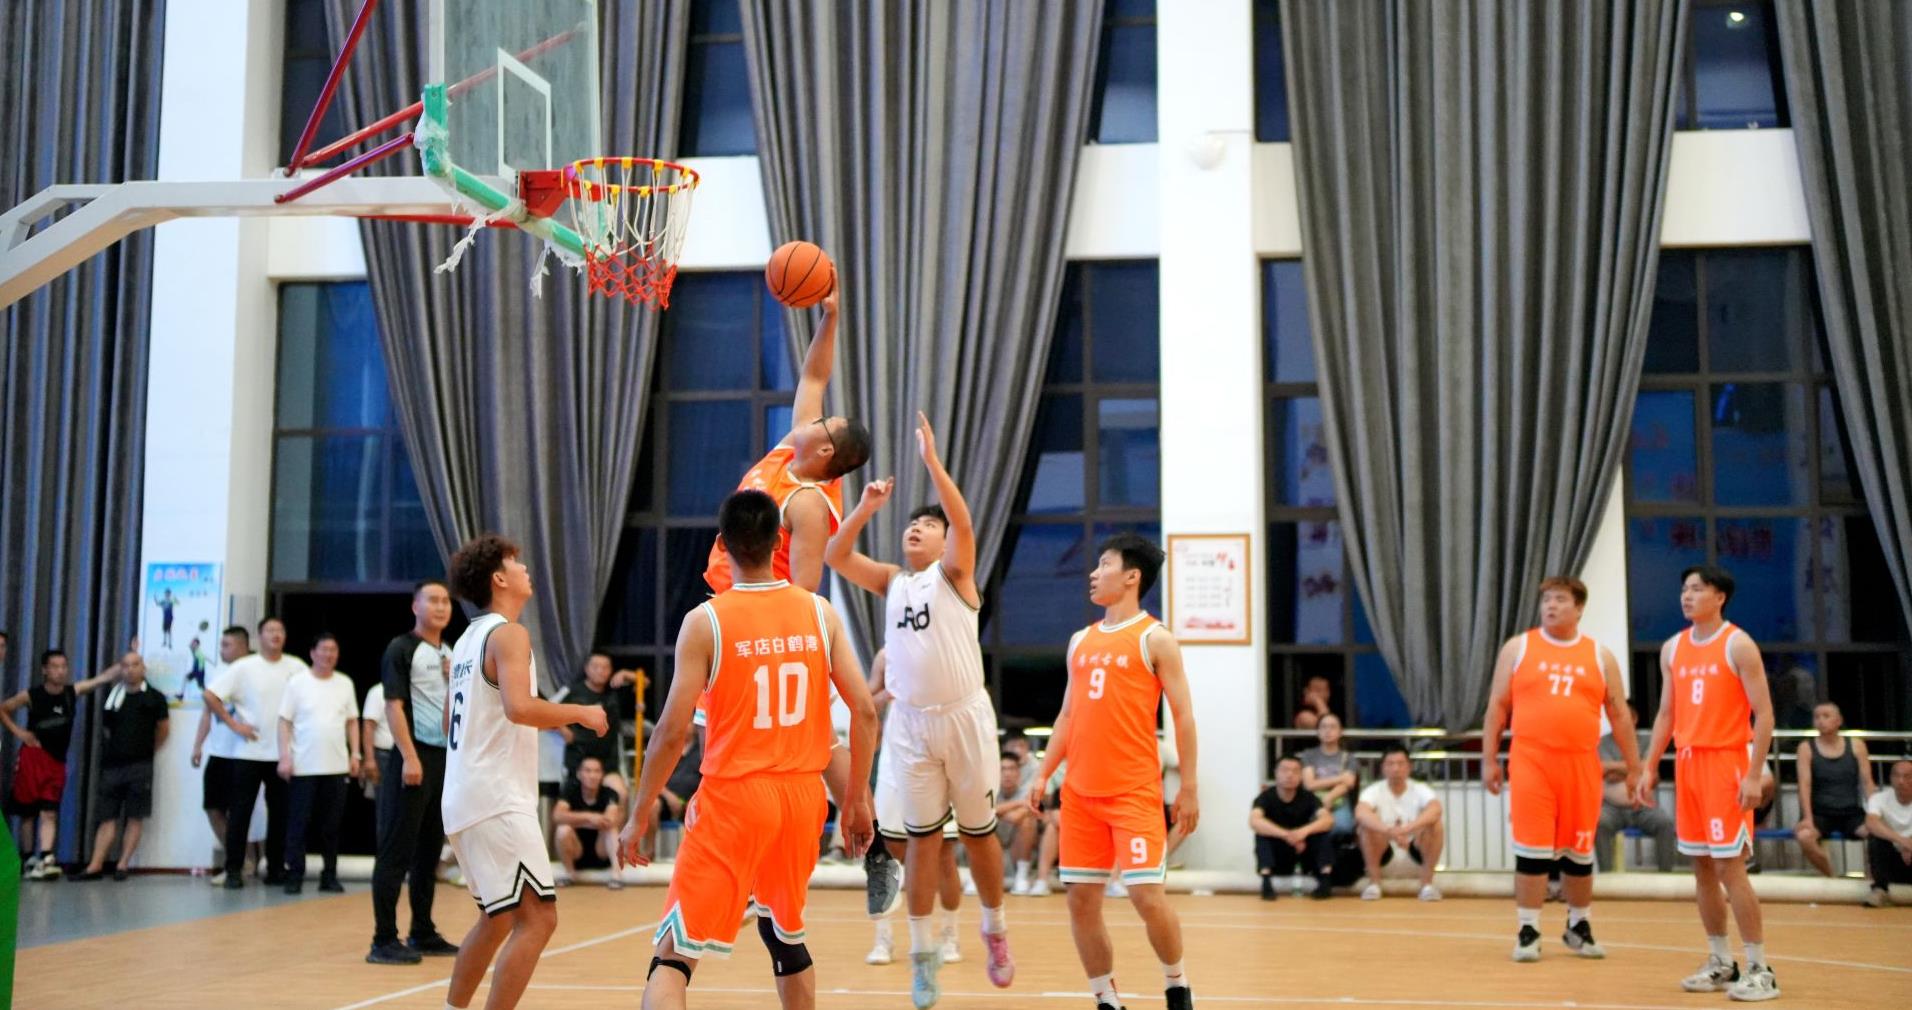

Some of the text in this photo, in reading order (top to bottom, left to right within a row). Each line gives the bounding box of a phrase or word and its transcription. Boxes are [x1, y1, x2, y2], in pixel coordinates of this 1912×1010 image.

[753, 662, 809, 729] 10
[1089, 667, 1106, 700] 9
[1548, 673, 1574, 697] 77
[1692, 679, 1704, 704] 8
[1711, 818, 1724, 842] 8
[1131, 837, 1148, 865] 9
